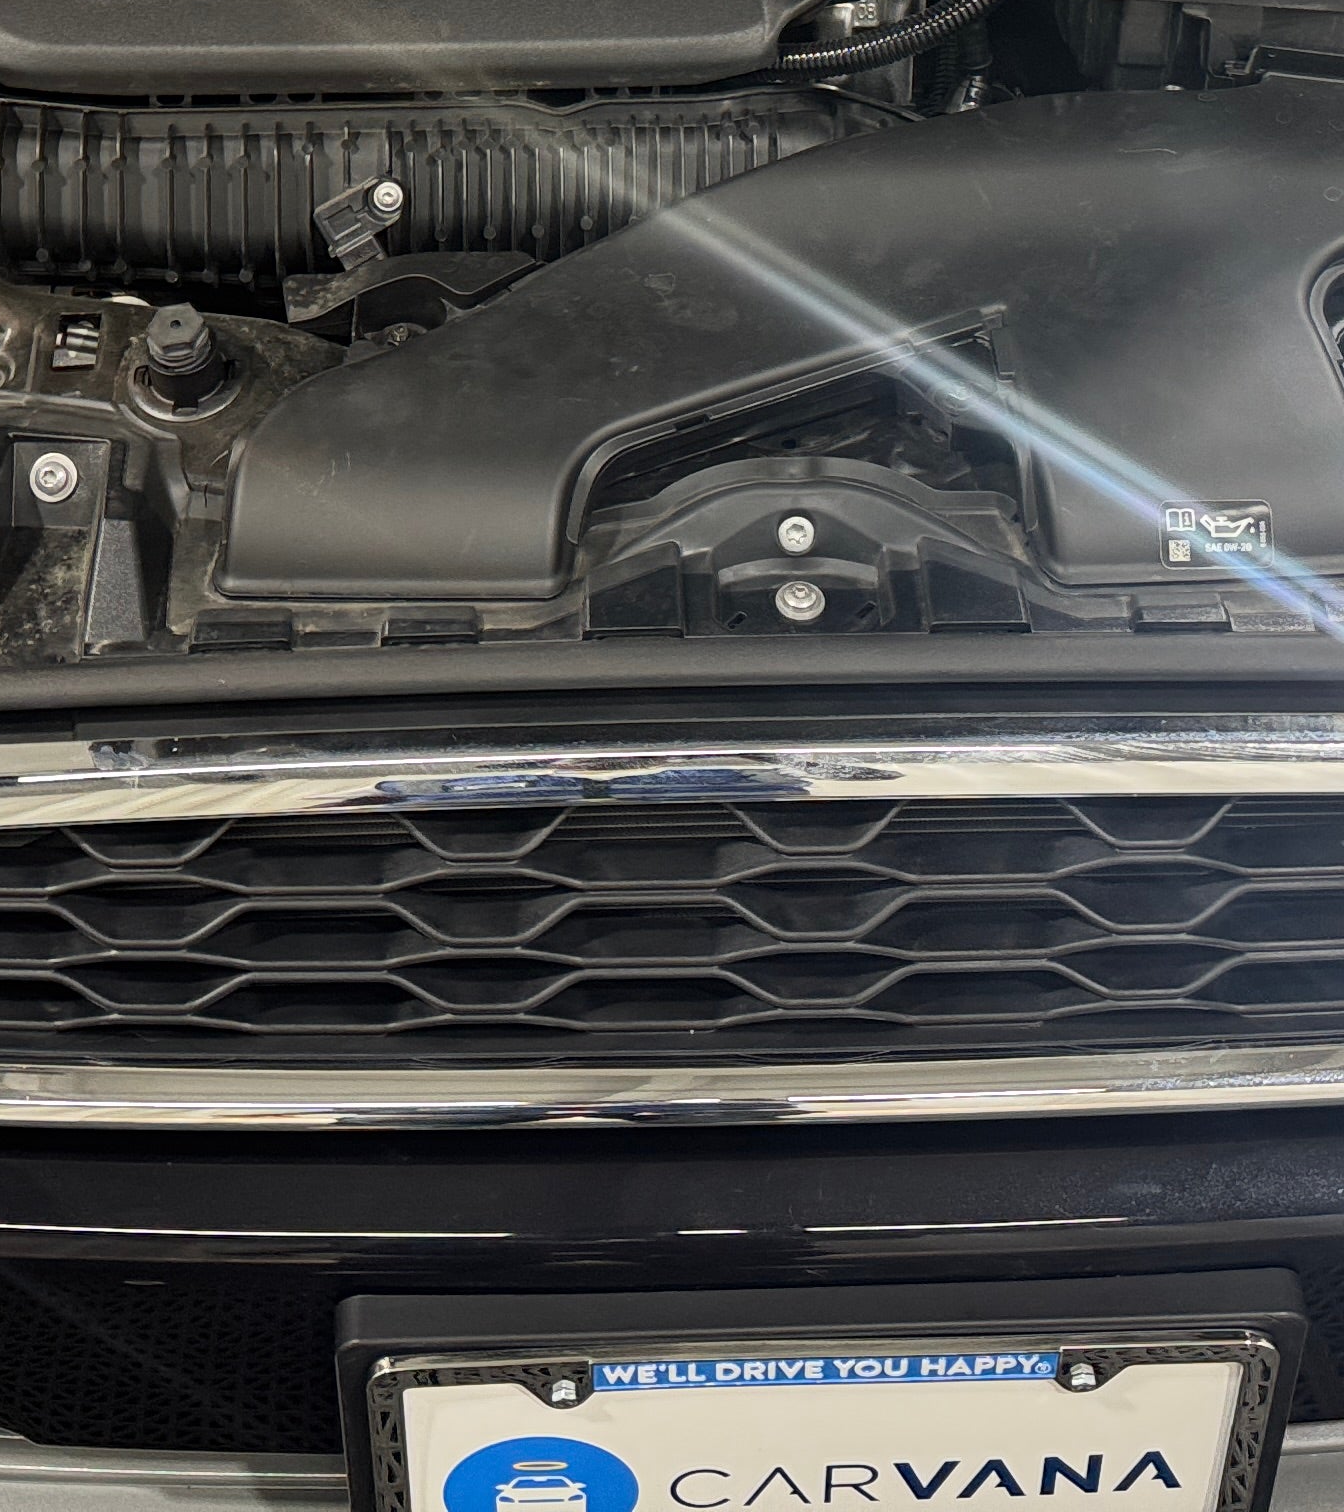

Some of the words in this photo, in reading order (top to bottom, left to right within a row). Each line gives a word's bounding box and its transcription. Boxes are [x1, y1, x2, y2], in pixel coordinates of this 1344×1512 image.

[1204, 542, 1223, 553] SAE
[602, 1363, 707, 1384] WE'LL
[715, 1359, 825, 1381] DRIVE
[833, 1357, 909, 1378] YOU
[669, 1450, 1183, 1509] CARVANA
